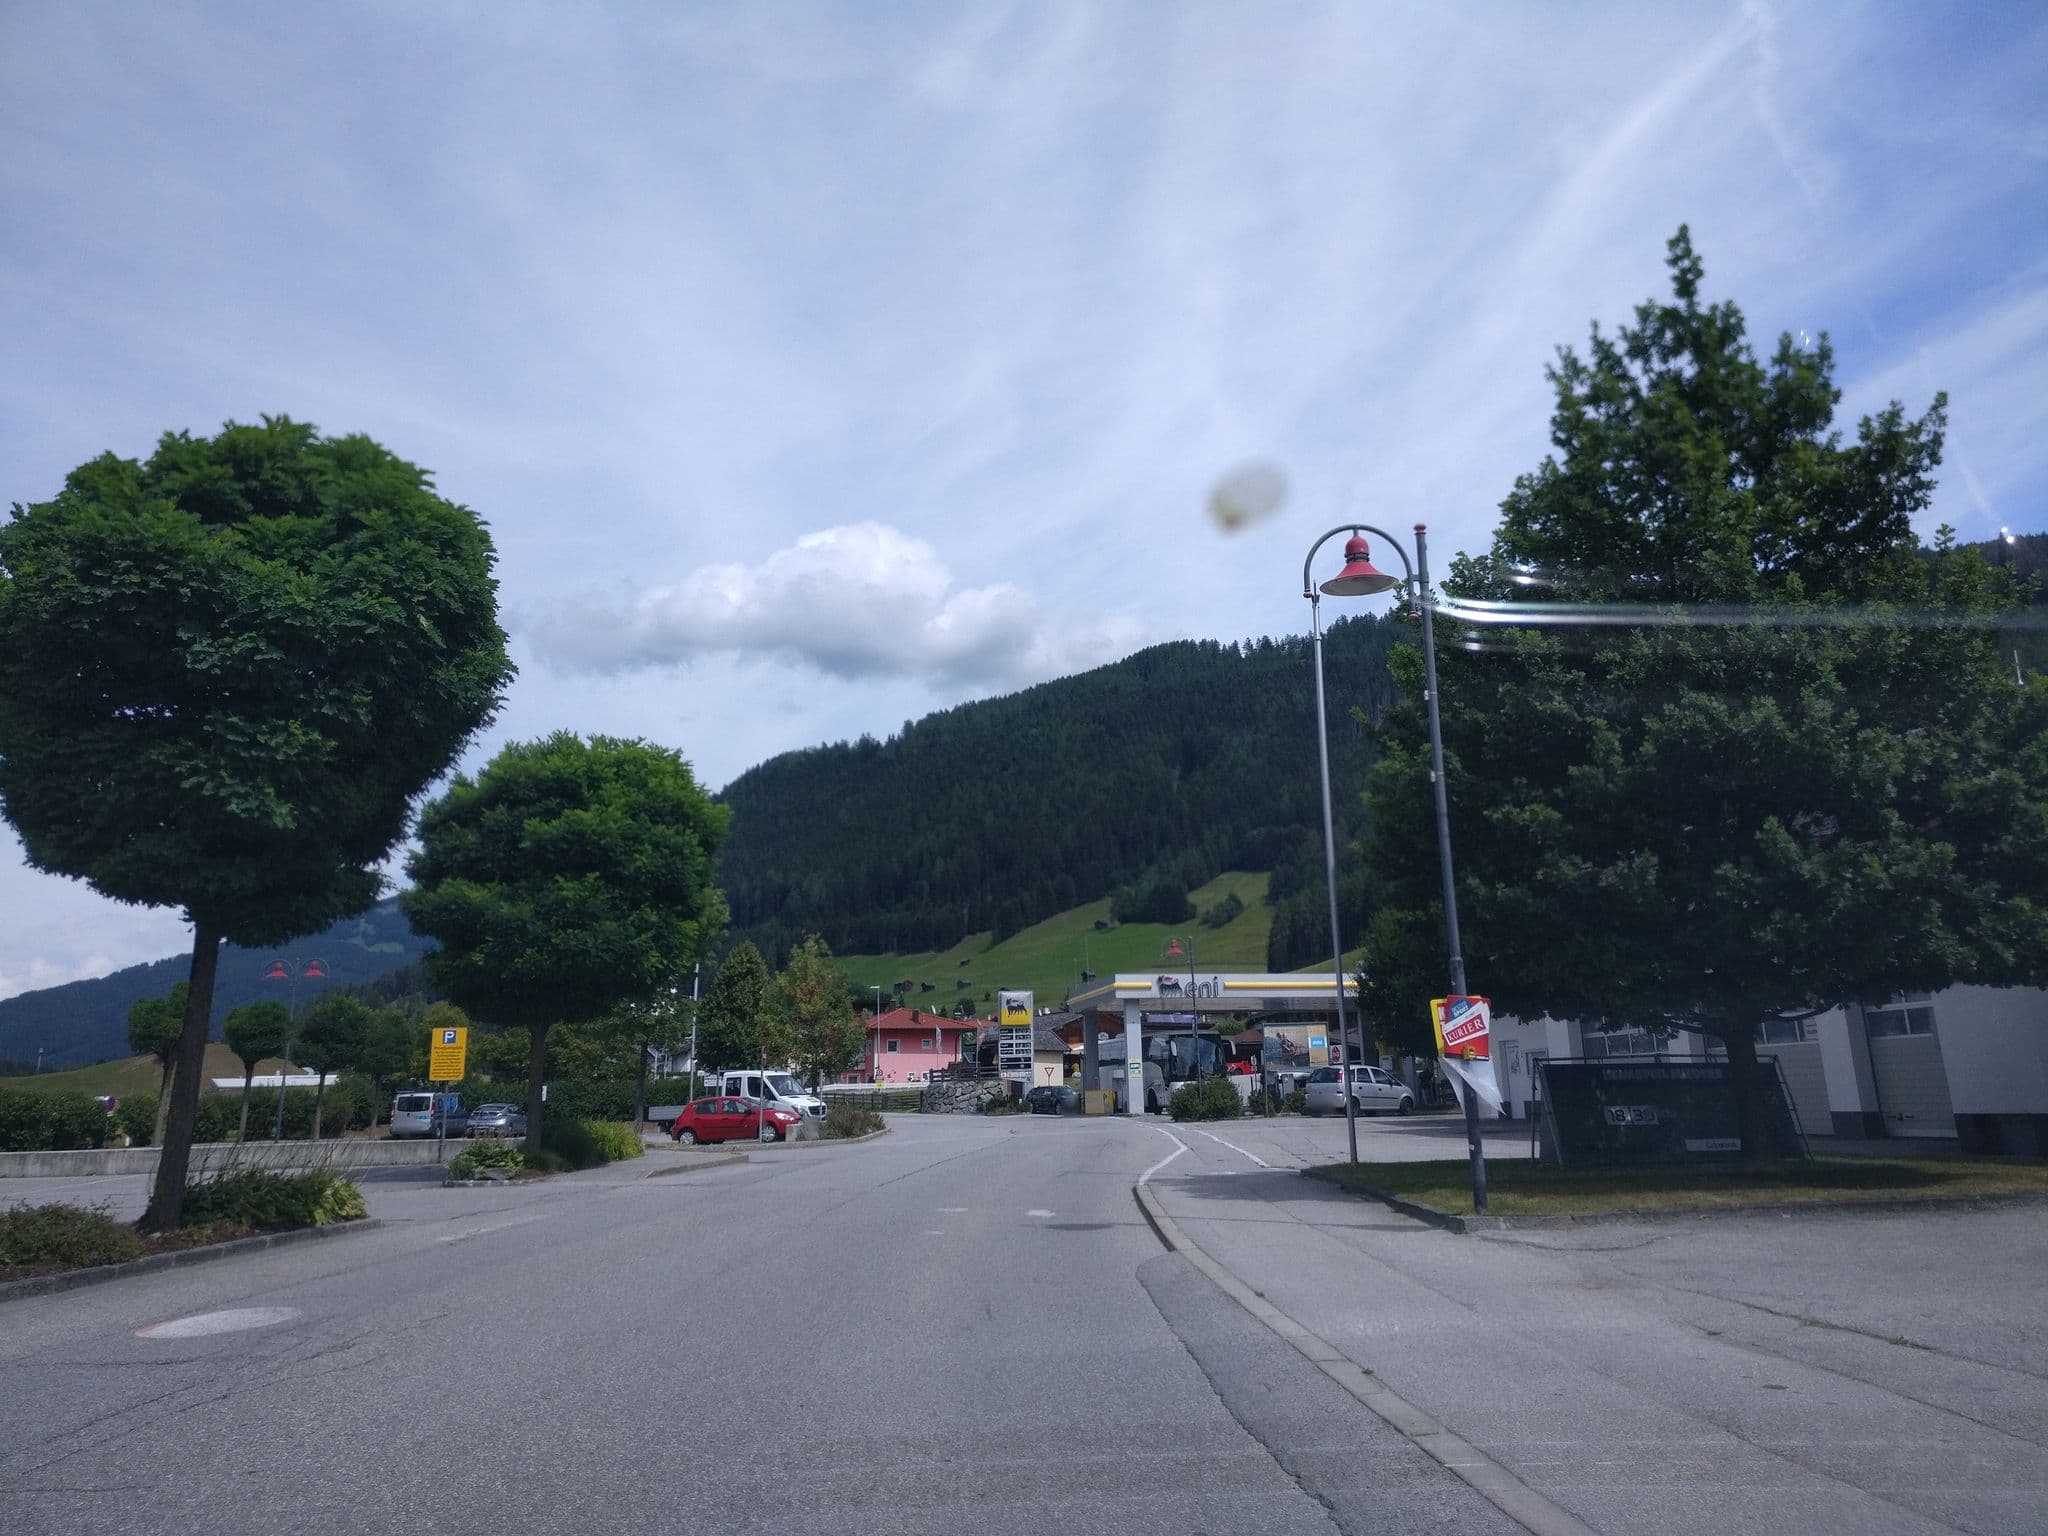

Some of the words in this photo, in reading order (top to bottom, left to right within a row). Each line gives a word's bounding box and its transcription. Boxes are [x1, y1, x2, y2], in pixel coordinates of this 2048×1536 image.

[1185, 976, 1219, 998] eni
[444, 1031, 455, 1043] P
[1447, 1018, 1484, 1041] KURIER
[1607, 1109, 1625, 1122] 18
